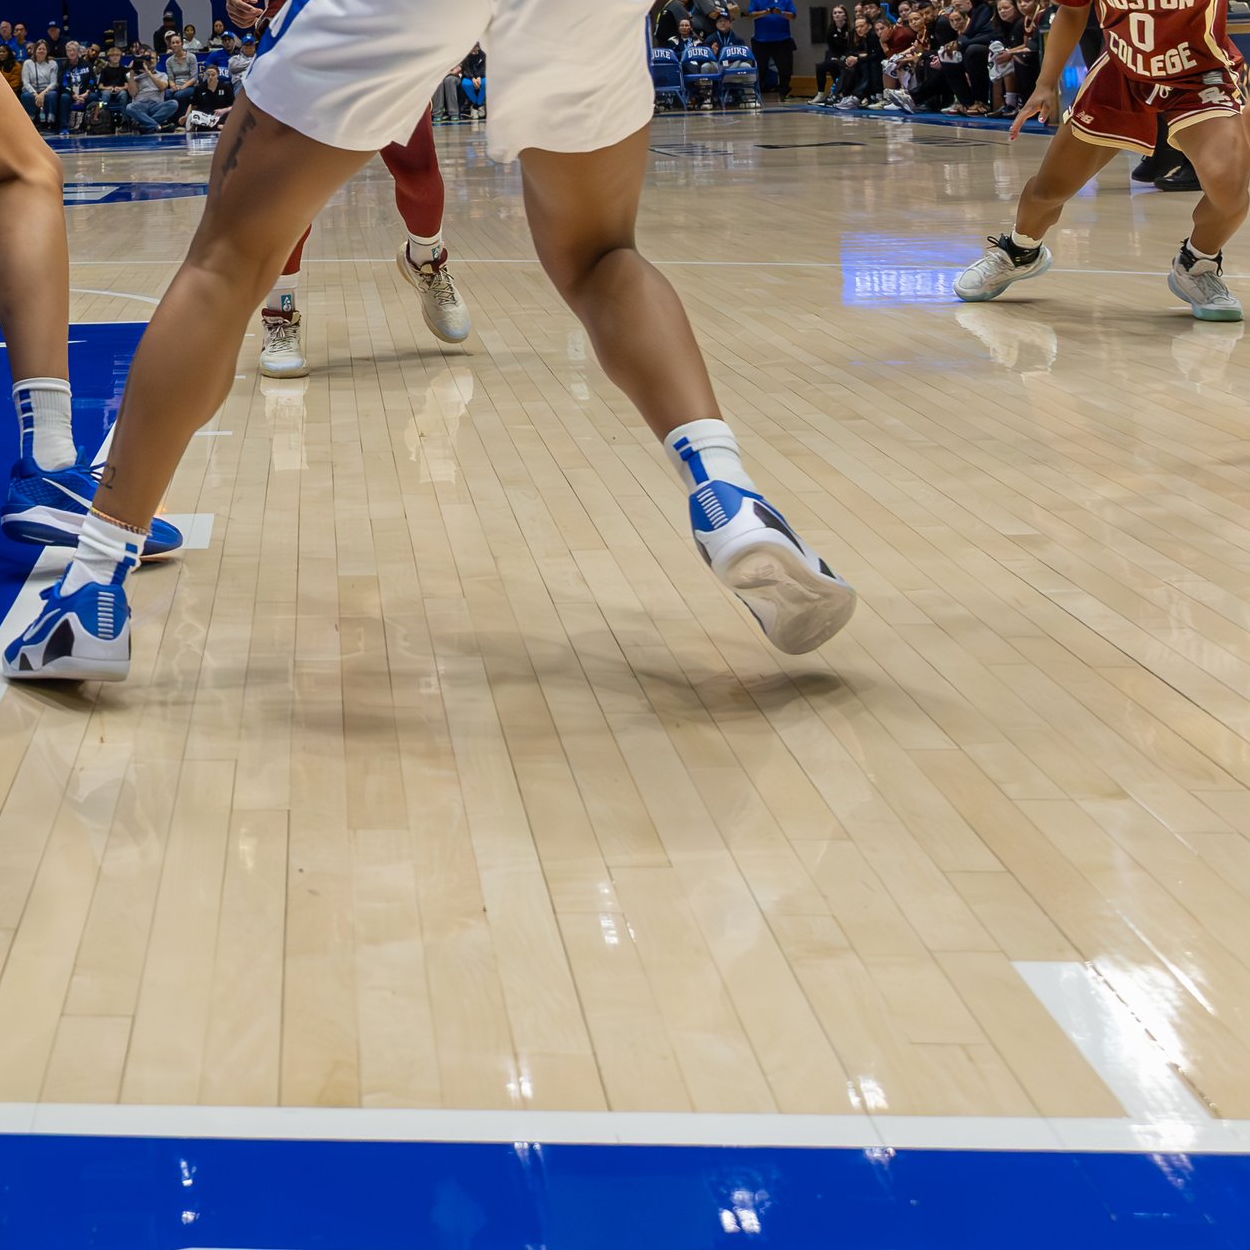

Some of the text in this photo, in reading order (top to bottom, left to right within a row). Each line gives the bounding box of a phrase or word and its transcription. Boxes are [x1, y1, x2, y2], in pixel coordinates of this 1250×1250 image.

[1129, 12, 1154, 52] 0
[688, 48, 709, 59] DUKE
[726, 45, 748, 57] DUKE
[1108, 30, 1198, 77] COLLEGE
